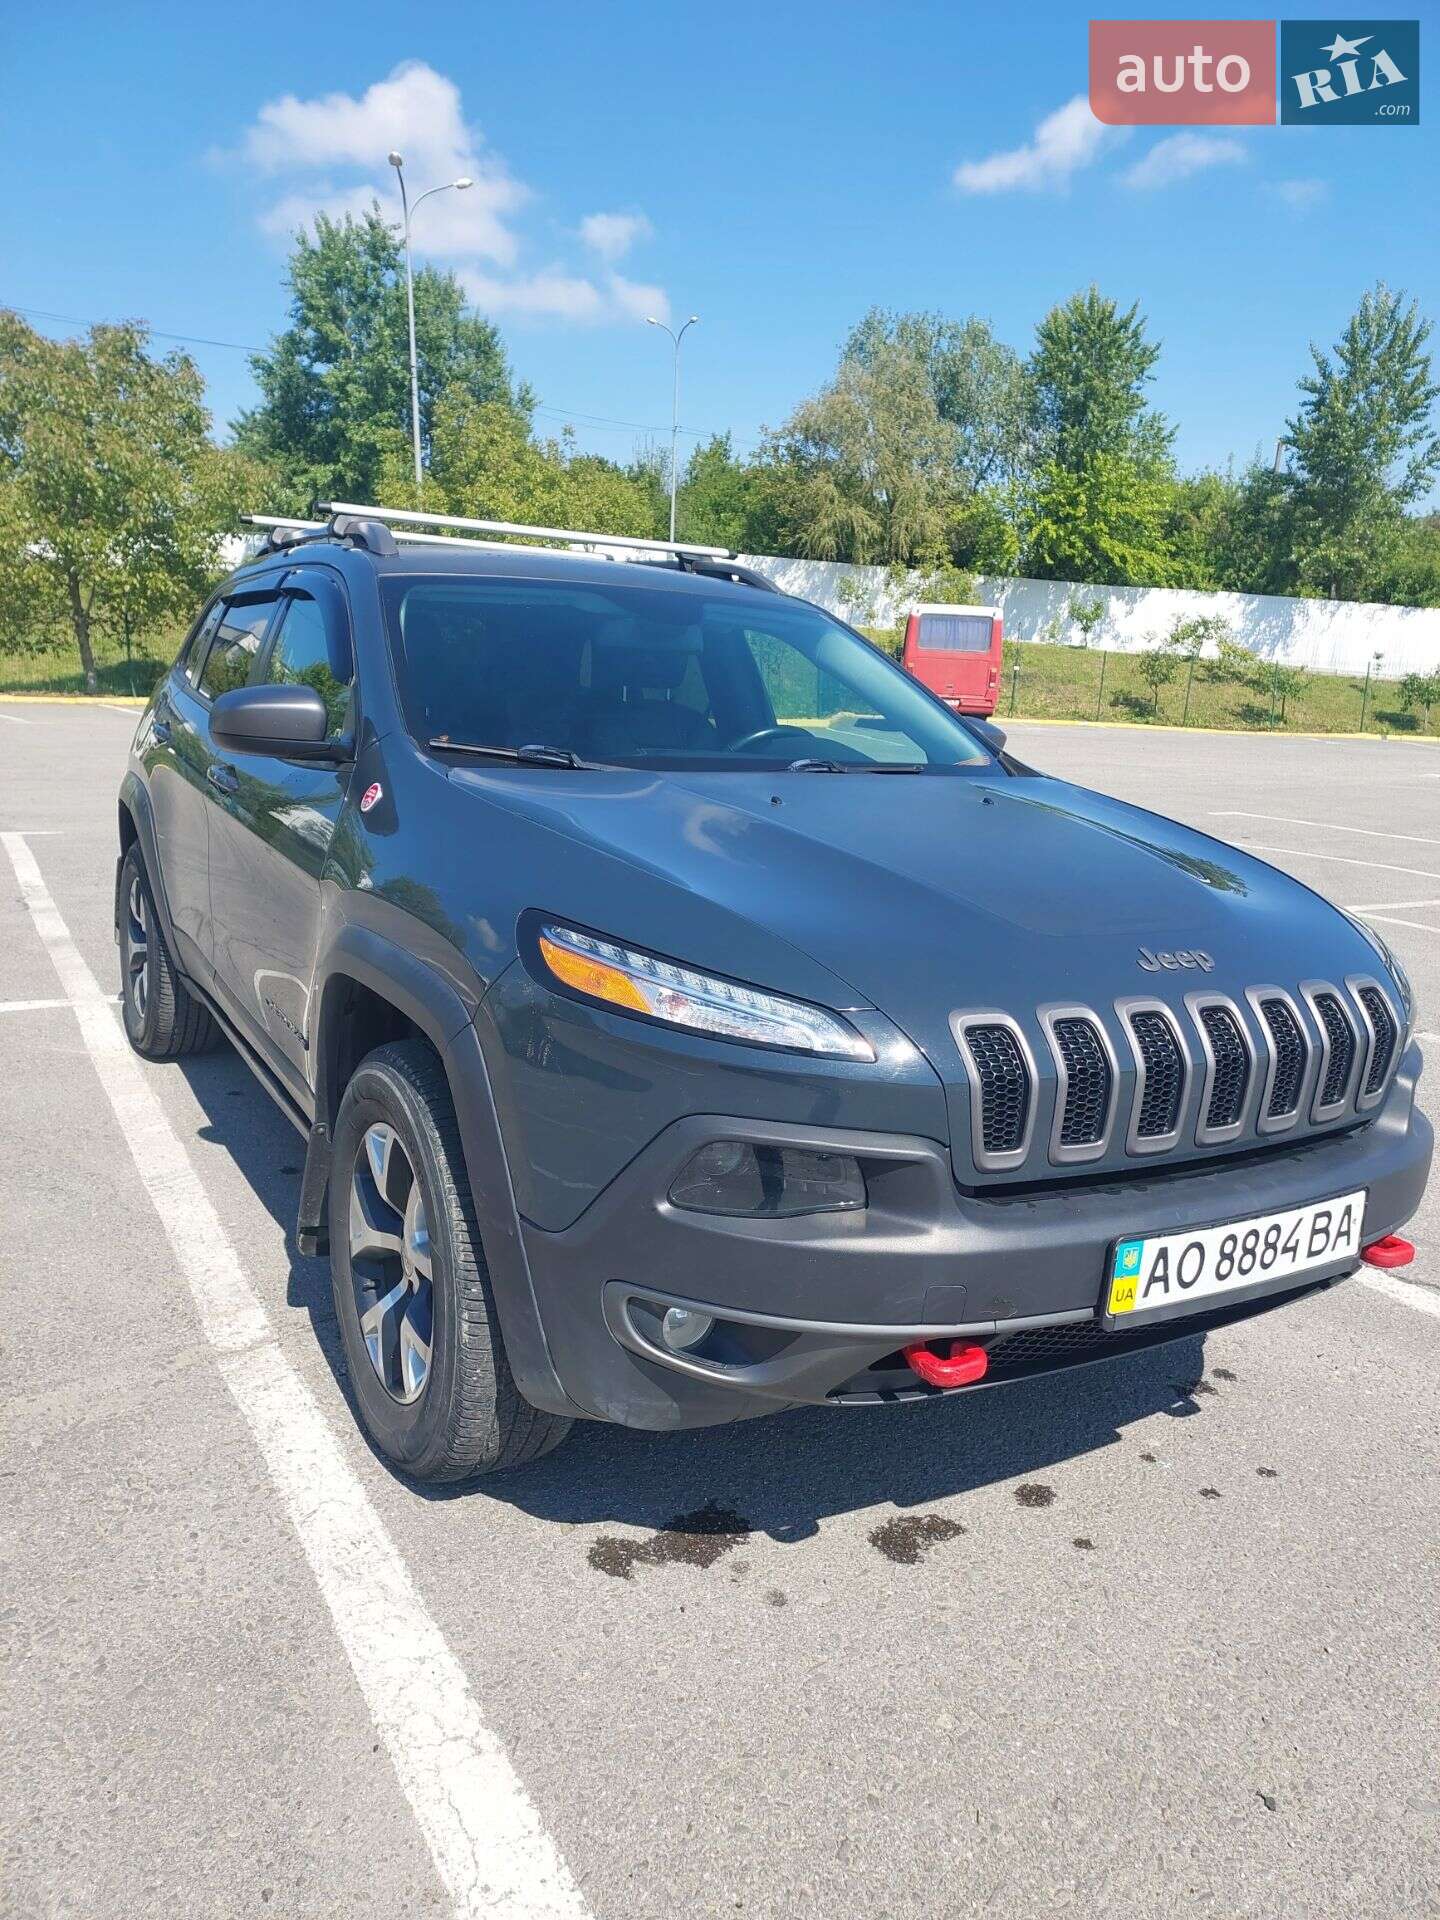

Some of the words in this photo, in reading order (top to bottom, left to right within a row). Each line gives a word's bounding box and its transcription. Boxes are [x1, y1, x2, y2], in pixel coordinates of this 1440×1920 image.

[1136, 944, 1216, 973] Jeep
[1142, 1241, 1206, 1298] AO
[1215, 1217, 1304, 1281] 8884
[1306, 1204, 1353, 1258] BA
[1115, 1288, 1134, 1303] UA
